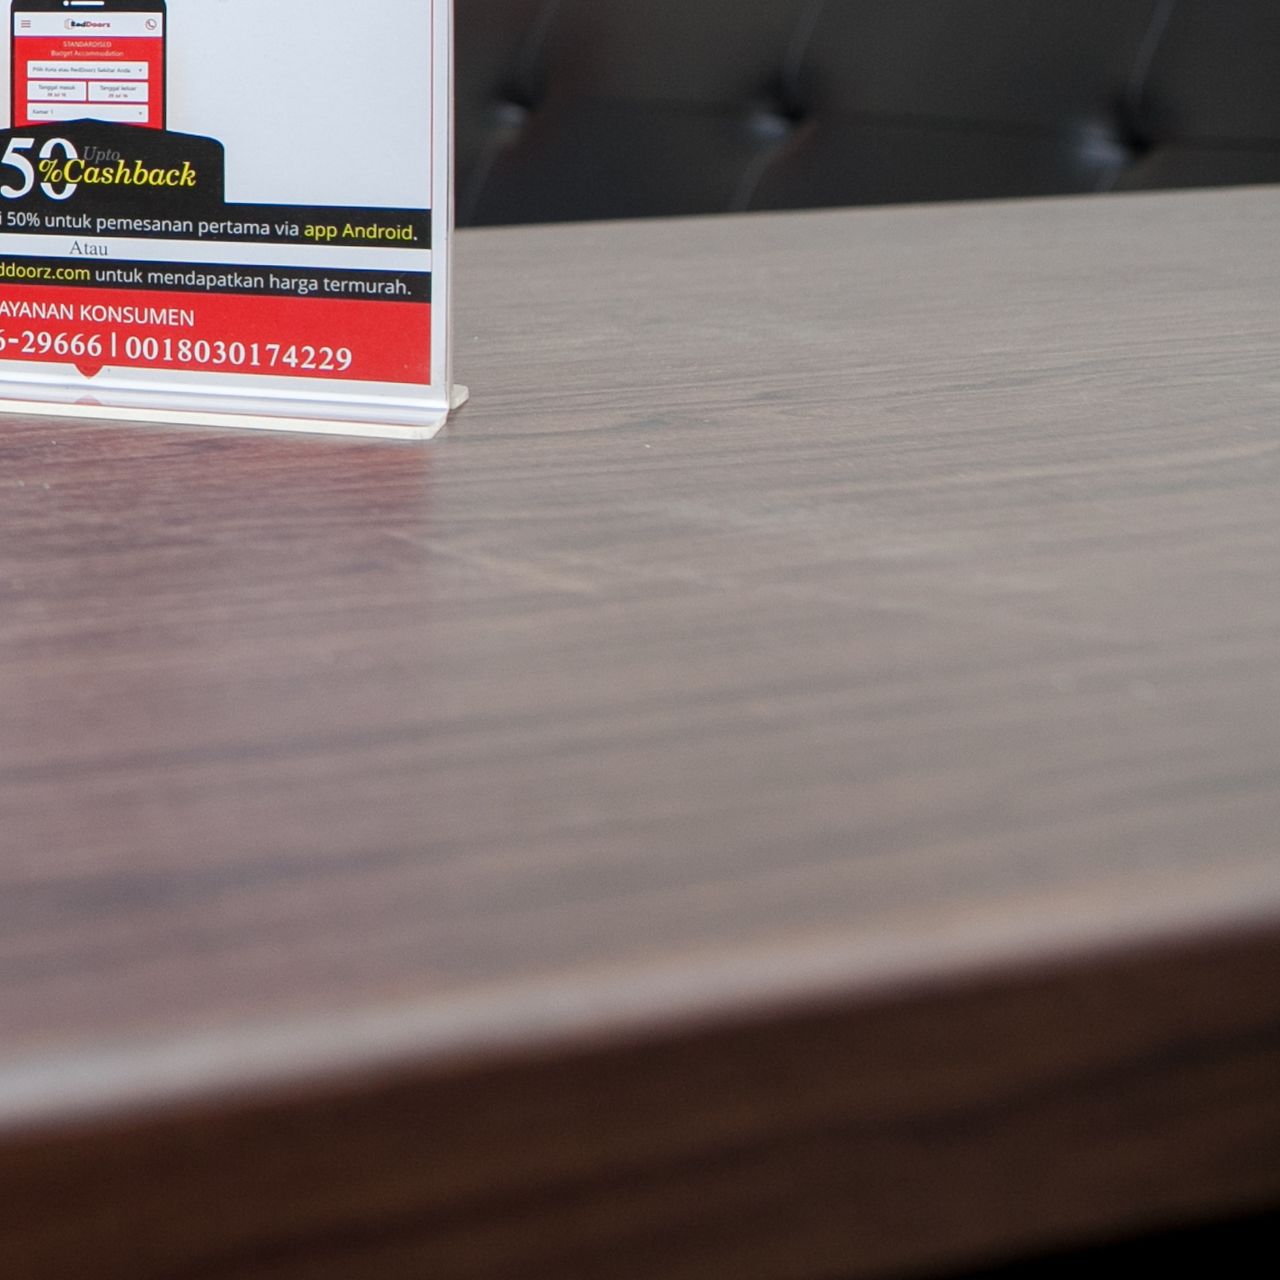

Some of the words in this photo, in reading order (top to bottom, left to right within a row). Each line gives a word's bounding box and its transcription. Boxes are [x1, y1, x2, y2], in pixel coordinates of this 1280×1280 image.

[83, 146, 121, 164] Upto
[7, 211, 40, 227] 50%
[44, 212, 91, 229] untuk
[96, 217, 194, 235] pemesanan
[197, 220, 271, 237] pertama
[274, 220, 299, 236] via
[304, 225, 337, 241] app
[342, 223, 418, 241] Android.
[69, 240, 109, 256] Atau
[95, 267, 143, 284] untuk
[147, 270, 264, 291] mendapatkan
[269, 273, 319, 296] harga
[323, 276, 412, 296] termurah.
[80, 303, 195, 327] KONSUMEN
[124, 336, 353, 371] 0018030174229
